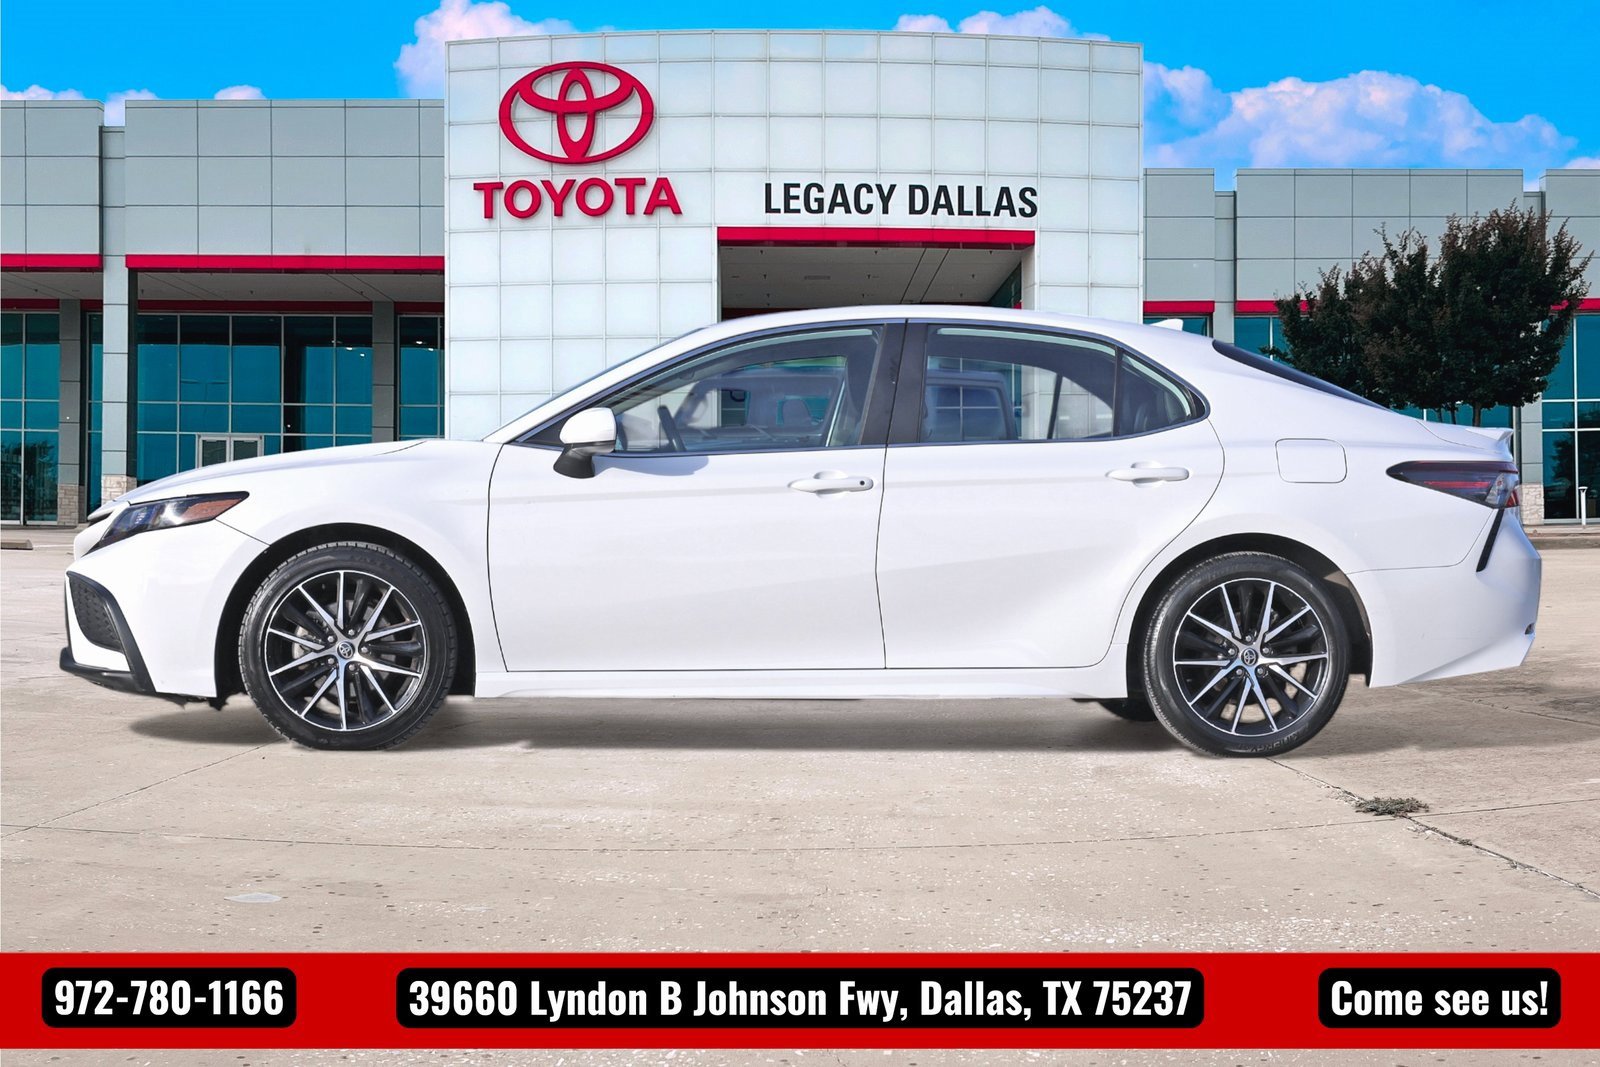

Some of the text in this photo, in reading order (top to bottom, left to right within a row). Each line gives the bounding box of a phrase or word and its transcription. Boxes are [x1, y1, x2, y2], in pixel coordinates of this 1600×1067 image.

[474, 177, 681, 219] TOYOTA
[765, 183, 1038, 217] LEGACY DALLAS
